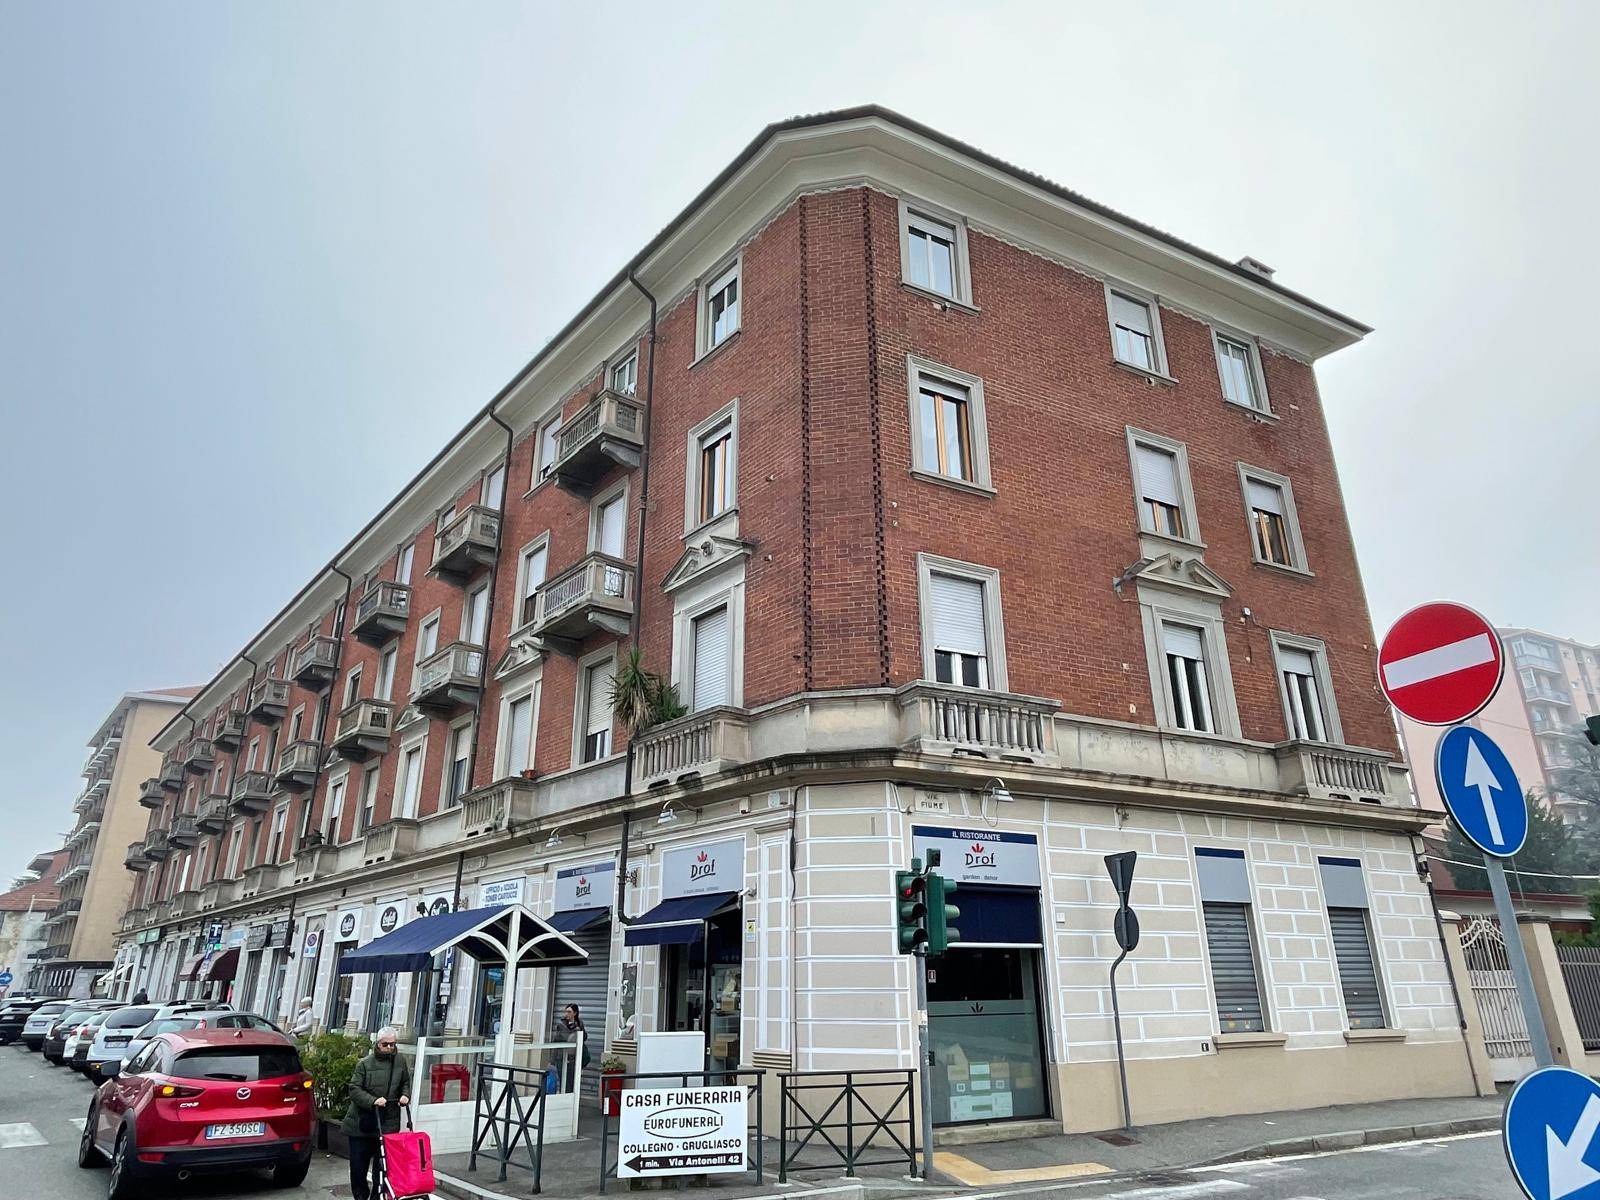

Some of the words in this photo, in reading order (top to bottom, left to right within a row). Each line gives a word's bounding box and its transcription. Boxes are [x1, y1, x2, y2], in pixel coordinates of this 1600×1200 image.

[920, 801, 944, 810] FIUME
[952, 830, 959, 838] IL
[960, 831, 1001, 841] RISTORANTE
[211, 924, 222, 937] T
[626, 1094, 661, 1107] CASA
[667, 1090, 741, 1106] FUNERARIA
[644, 1116, 724, 1130] EUROFUNERALI
[623, 1142, 674, 1154] COLLEGNO
[682, 1138, 742, 1151] GRUGLIASCO
[645, 1159, 660, 1168] min.
[668, 1158, 683, 1168] Via
[685, 1155, 726, 1167] Antonelli
[728, 1155, 740, 1164] 42
